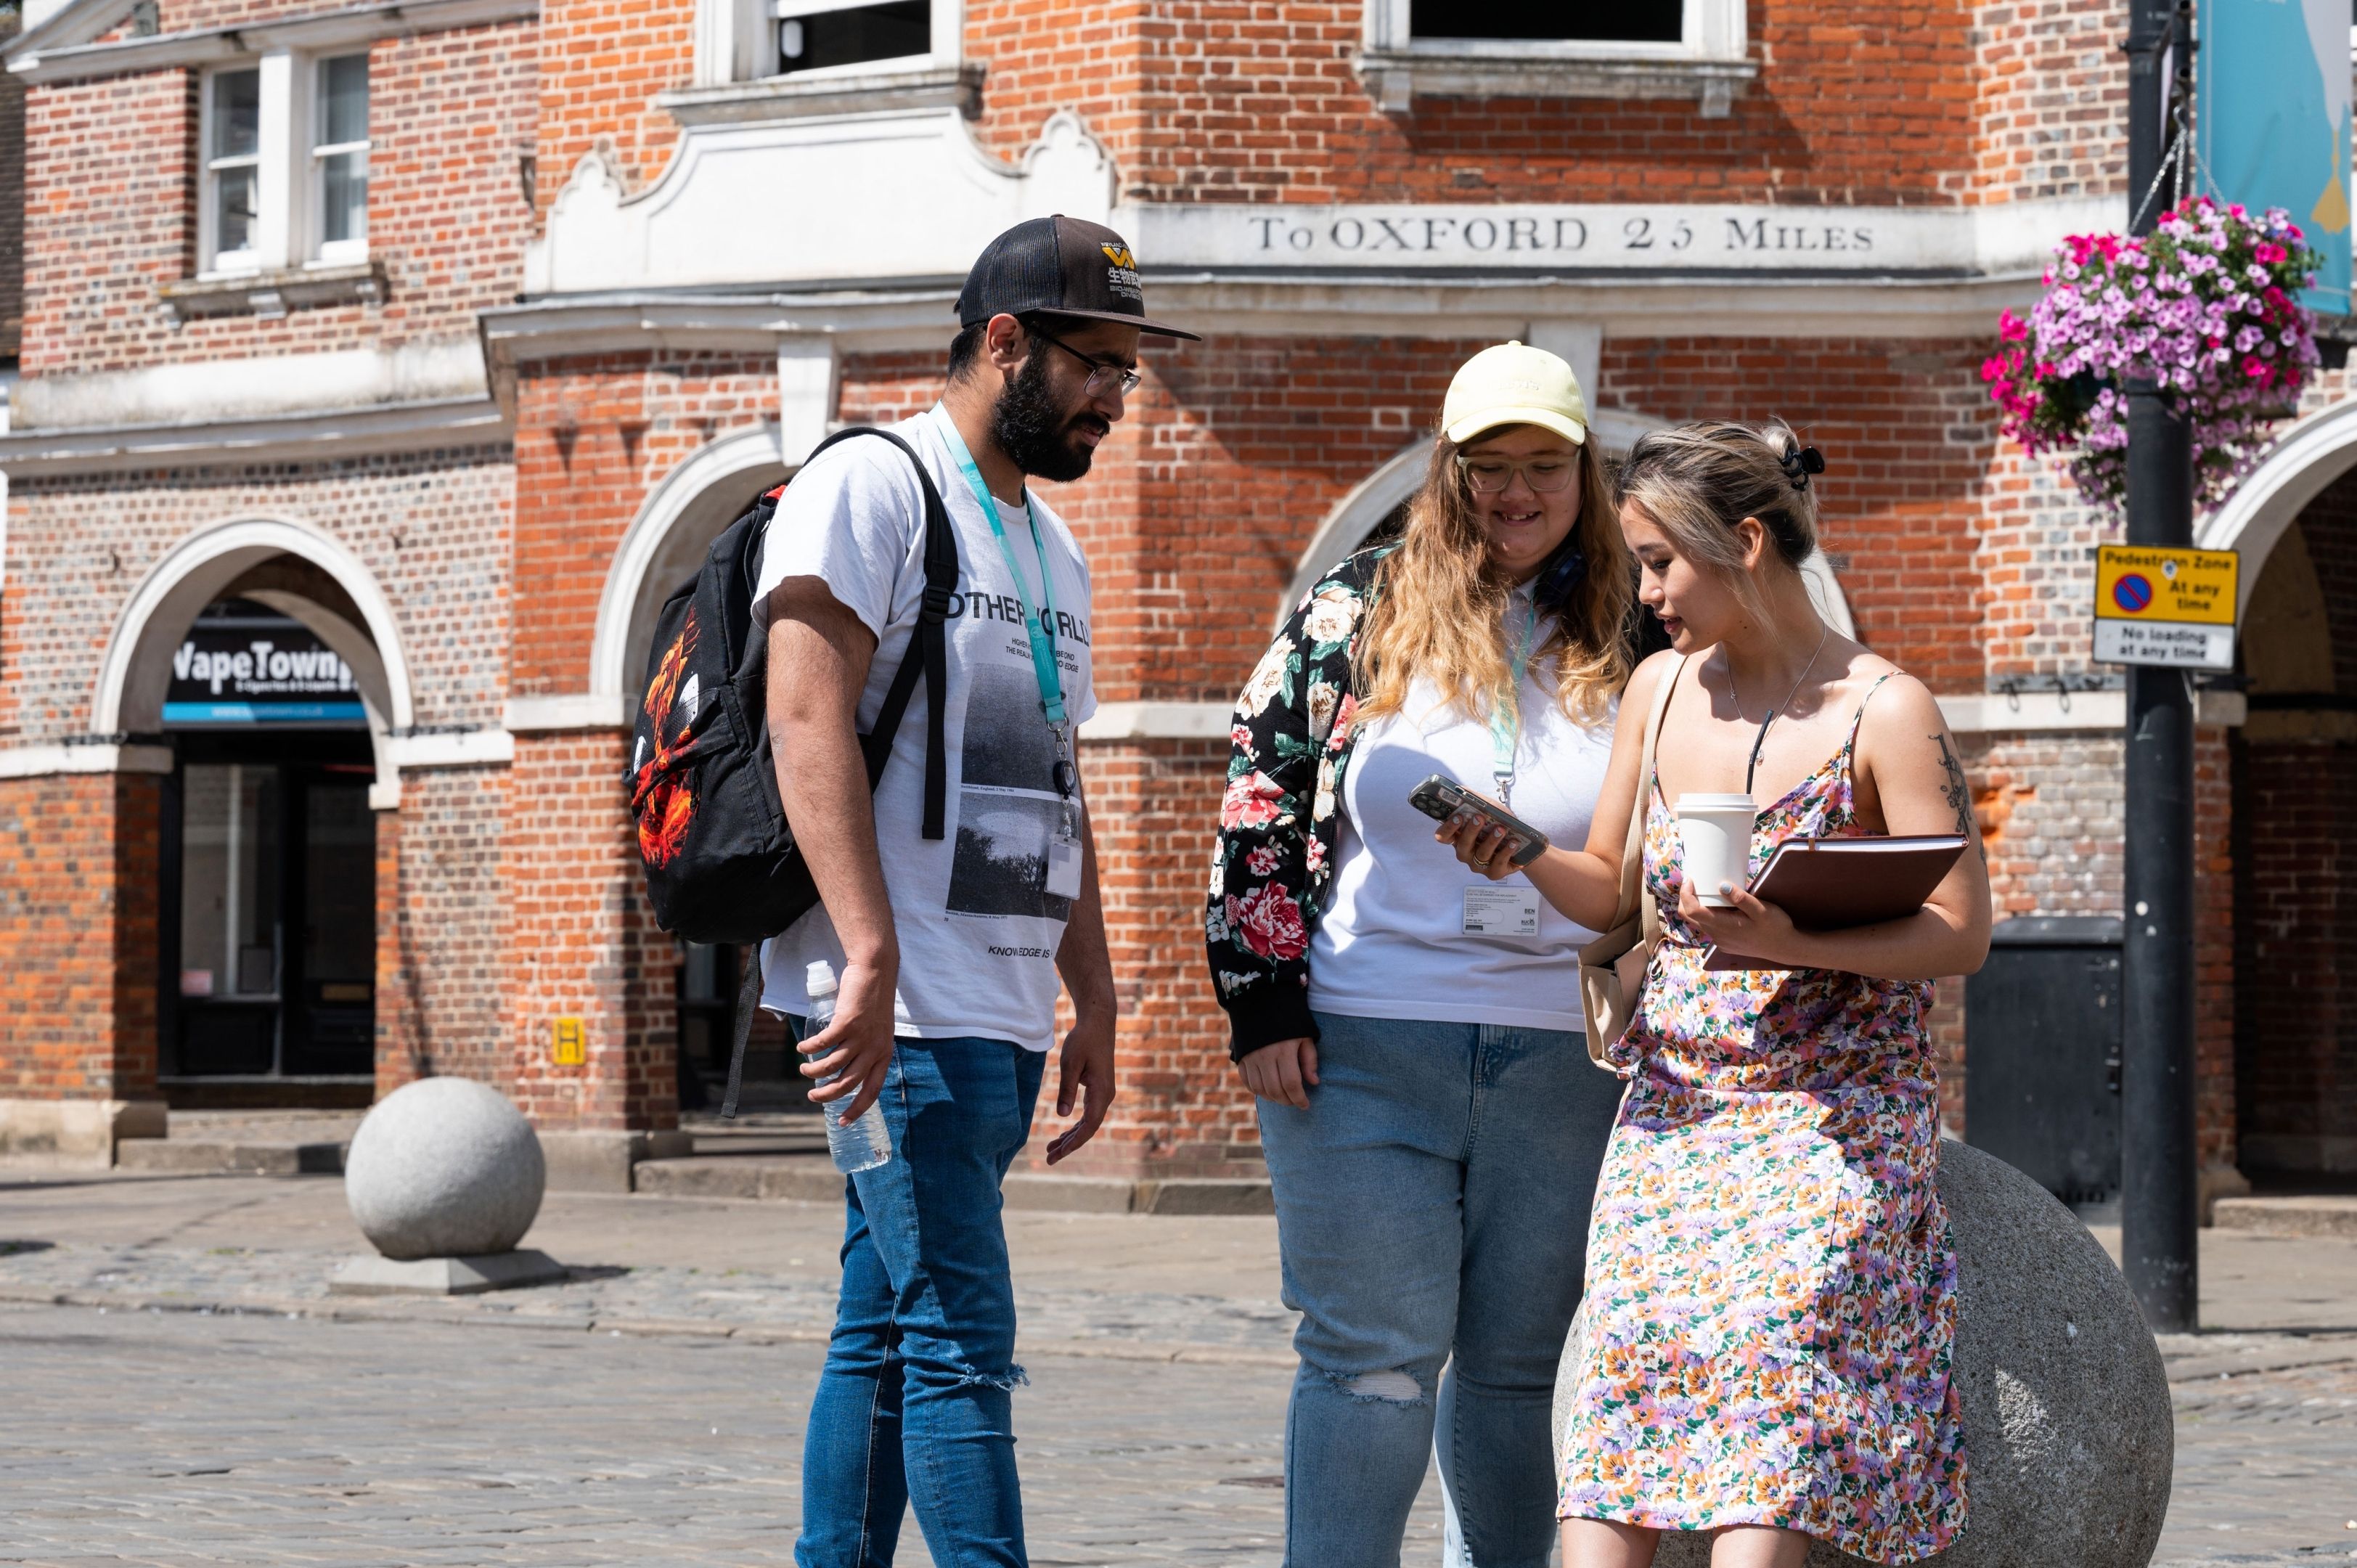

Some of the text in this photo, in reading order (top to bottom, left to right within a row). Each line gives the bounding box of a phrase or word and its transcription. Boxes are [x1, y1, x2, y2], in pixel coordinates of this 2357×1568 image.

[1330, 217, 1588, 251] OXFORD
[2194, 555, 2231, 570] Zone
[2169, 581, 2221, 597] At any
[2177, 598, 2211, 611] time
[947, 591, 1090, 648] OTHERORLD
[2122, 626, 2207, 645] No loading
[1006, 645, 1016, 655] THE
[1056, 650, 1075, 661] BEOND
[2120, 645, 2207, 660] at any time
[173, 641, 339, 695] VapeTown
[988, 945, 1050, 958] KNOWEDGE IS
